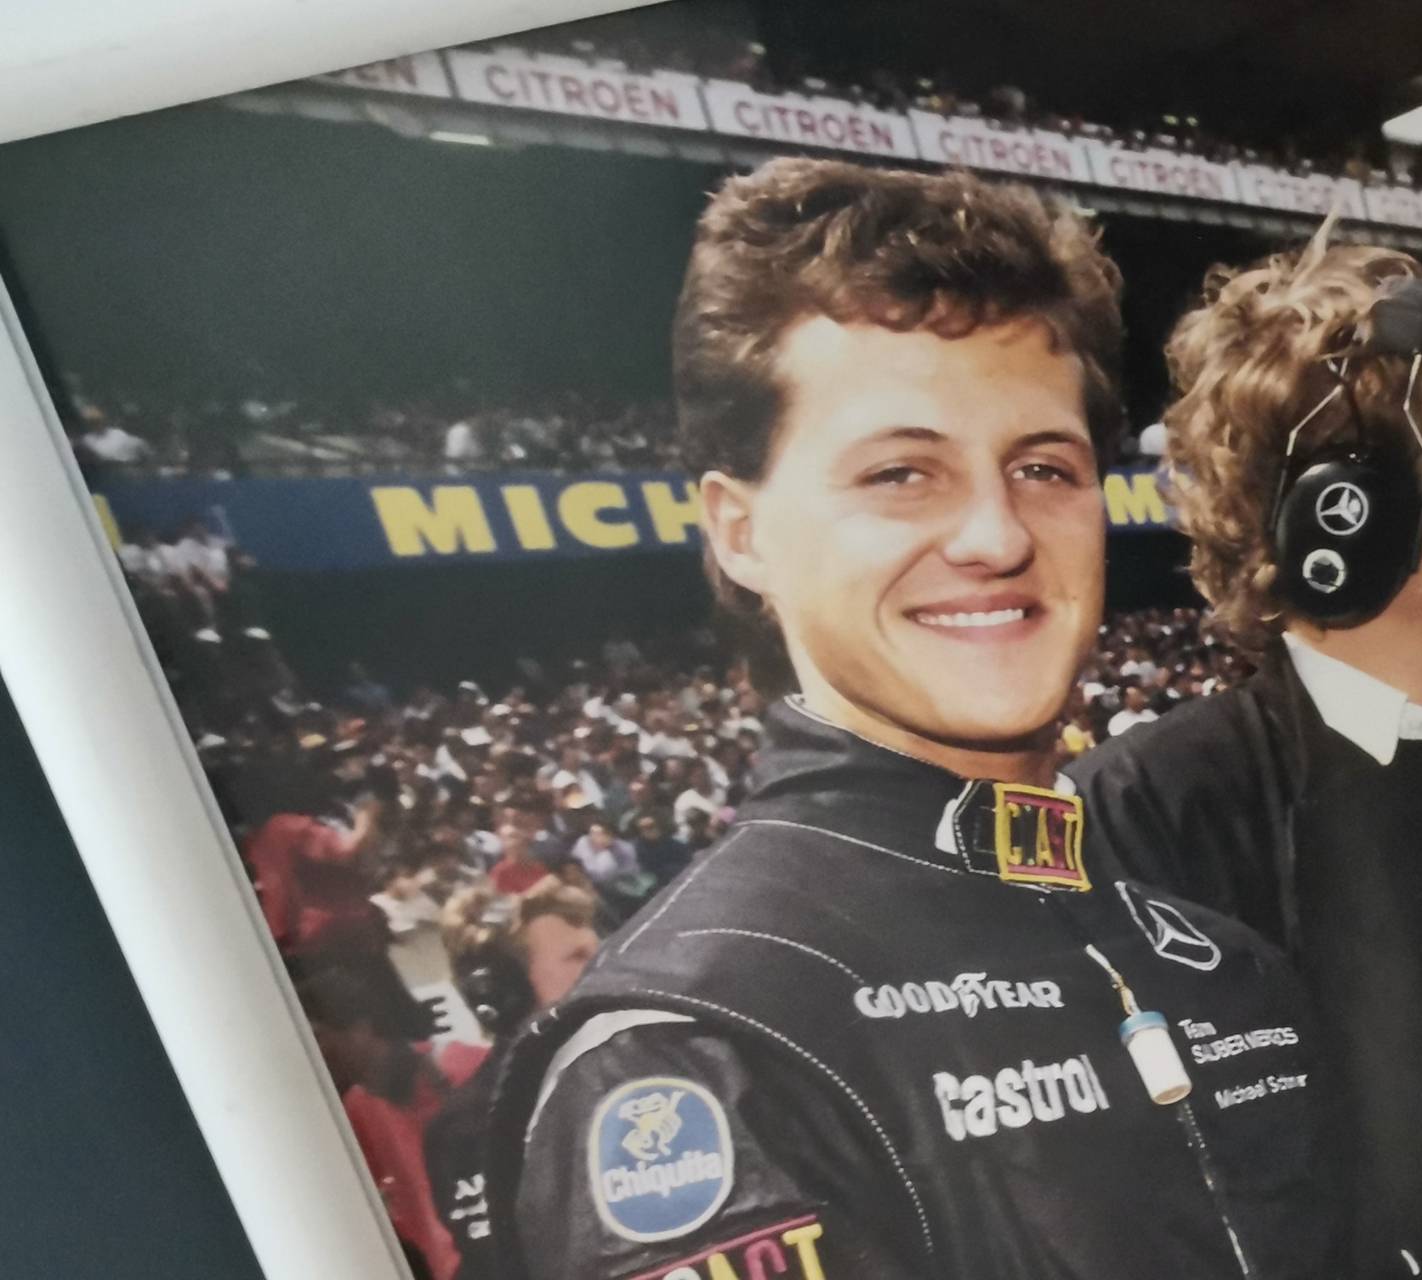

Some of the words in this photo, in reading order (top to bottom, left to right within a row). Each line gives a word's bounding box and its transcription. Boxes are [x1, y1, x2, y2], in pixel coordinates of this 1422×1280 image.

[853, 971, 1065, 1018] GOODYEAR
[933, 1054, 1110, 1141] Castrol
[604, 1150, 723, 1203] Chiquita
